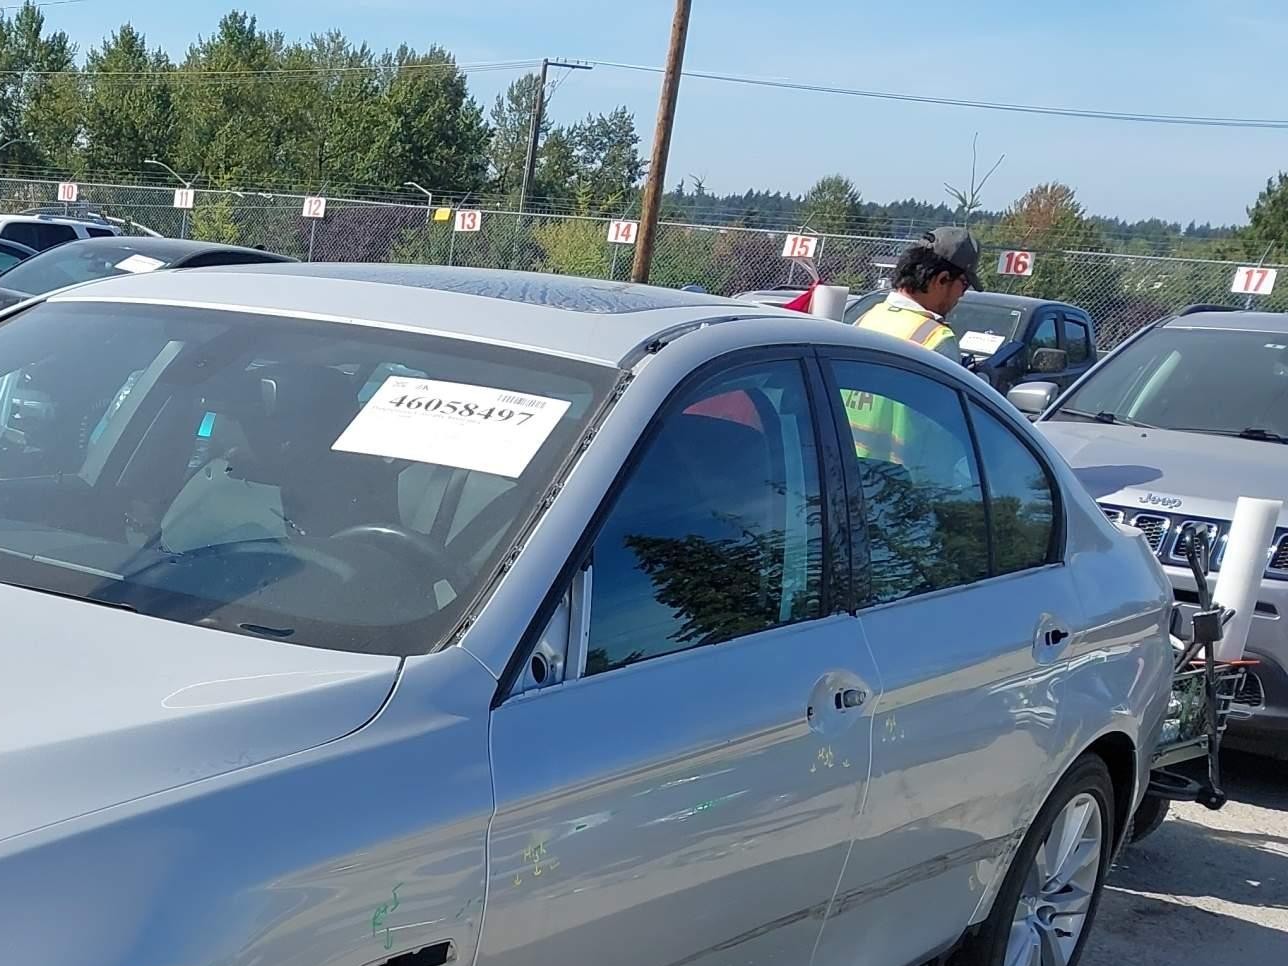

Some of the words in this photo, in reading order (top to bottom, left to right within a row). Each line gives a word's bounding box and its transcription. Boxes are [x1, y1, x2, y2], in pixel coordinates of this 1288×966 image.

[61, 185, 74, 200] 10
[179, 191, 189, 207] 11
[307, 199, 322, 216] 12
[460, 212, 477, 230] 13
[614, 222, 632, 242] 14
[790, 237, 810, 257] 15
[1005, 252, 1029, 274] 16
[1243, 269, 1269, 292] 17
[389, 394, 536, 426] 46058497
[1138, 492, 1183, 509] Jeep
